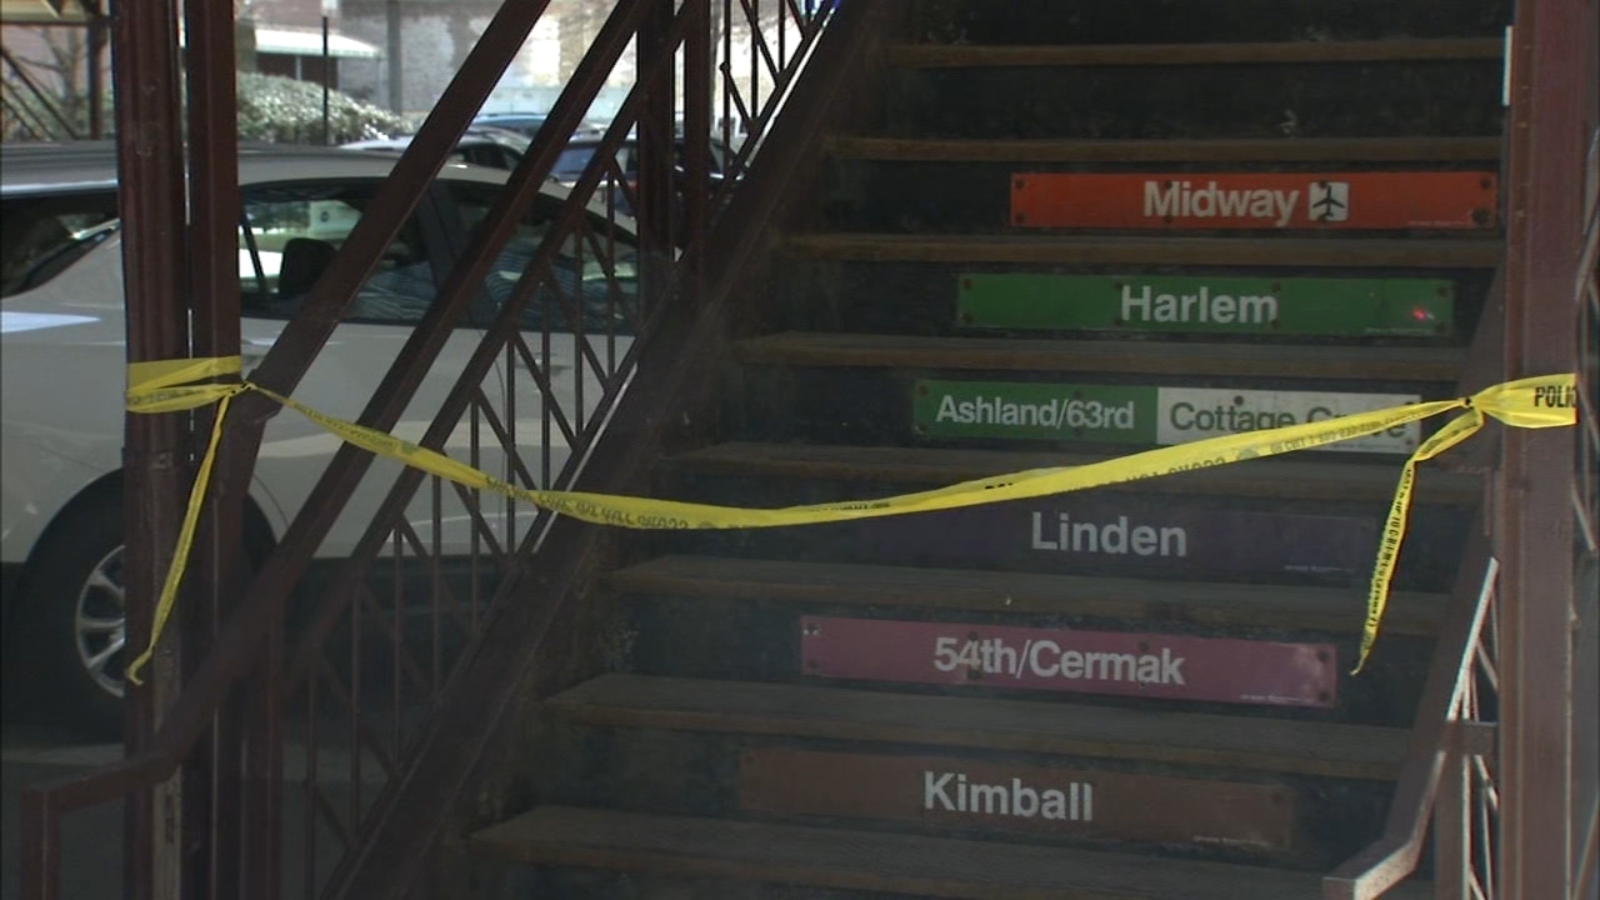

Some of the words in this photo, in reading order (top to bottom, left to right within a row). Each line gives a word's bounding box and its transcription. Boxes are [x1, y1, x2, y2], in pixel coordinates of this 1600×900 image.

[1143, 180, 1299, 226] Midway
[1121, 285, 1277, 324] Harlem
[935, 395, 1135, 431] Ashland/63rd
[1169, 401, 1295, 433] Cottage
[1031, 512, 1187, 557] Linden
[934, 637, 1186, 686] 54th/Cermak
[923, 771, 1093, 823] Kimball
